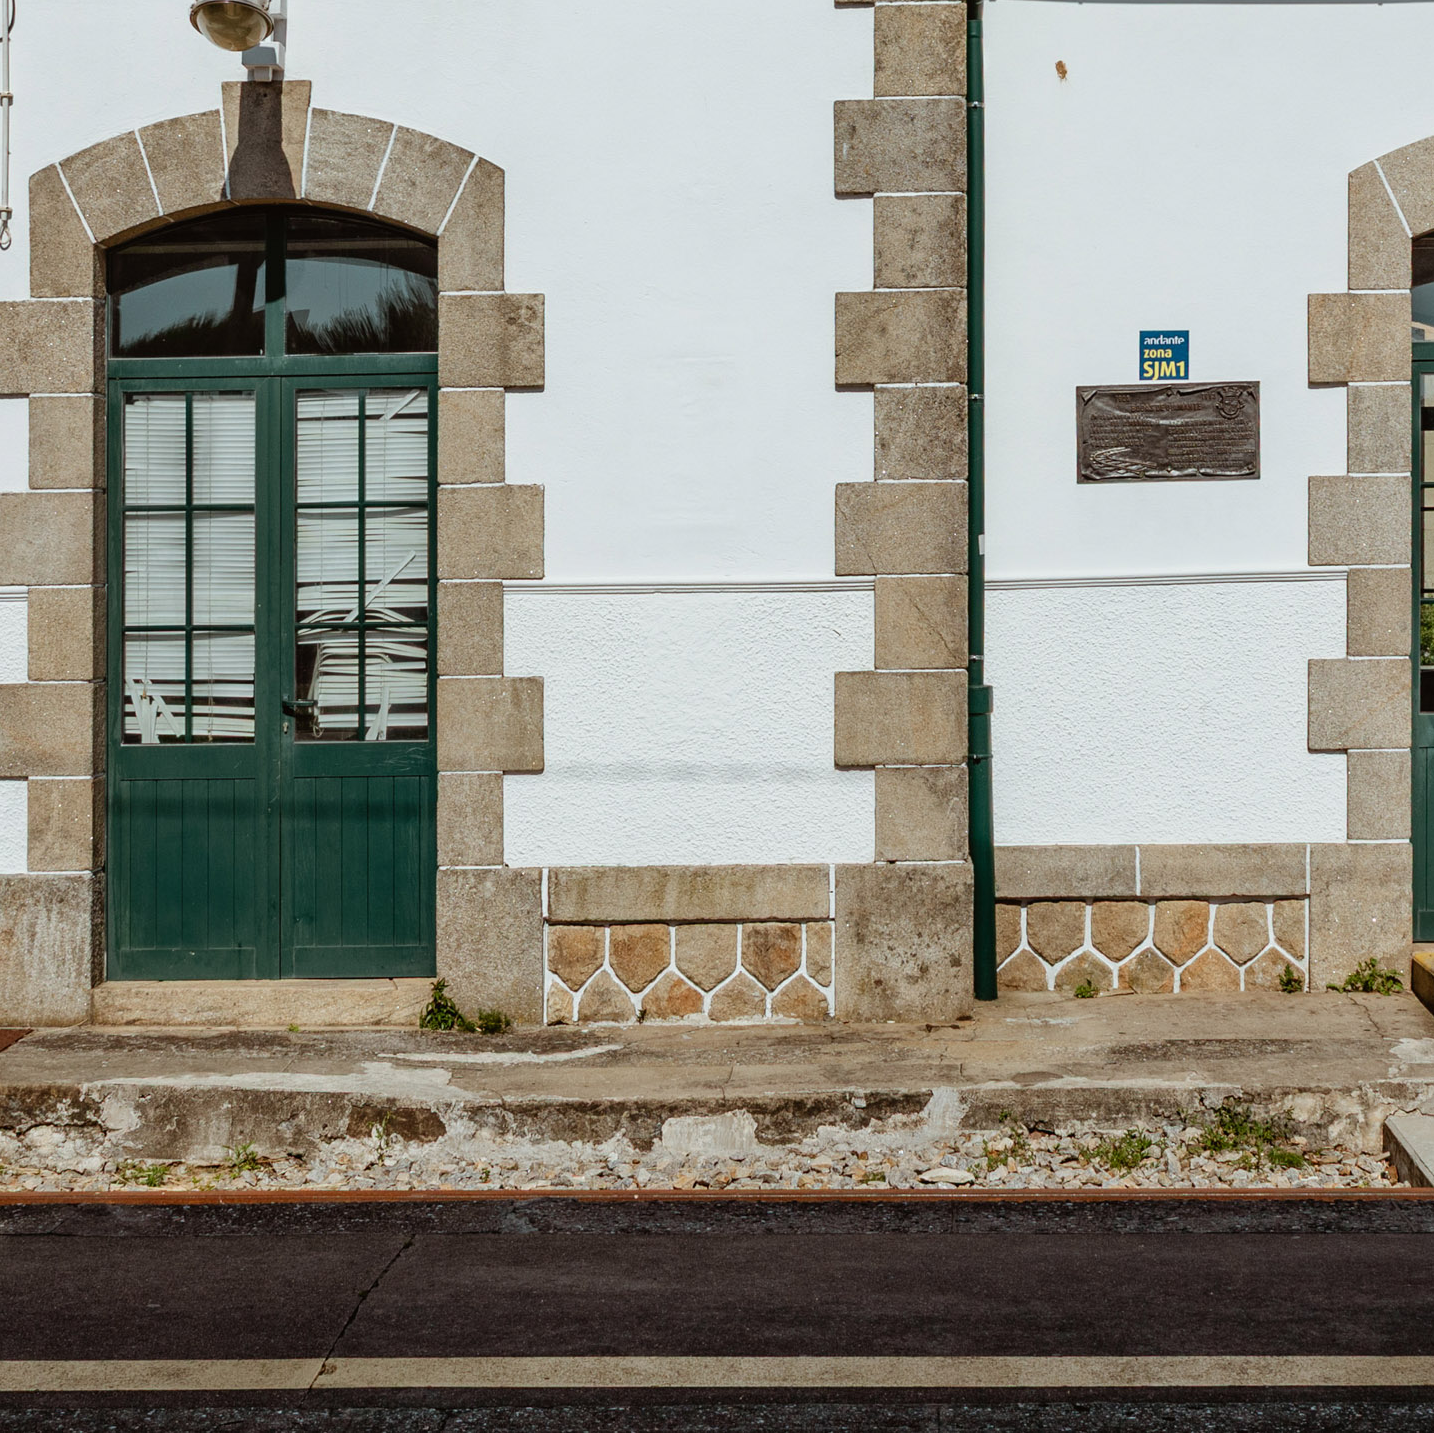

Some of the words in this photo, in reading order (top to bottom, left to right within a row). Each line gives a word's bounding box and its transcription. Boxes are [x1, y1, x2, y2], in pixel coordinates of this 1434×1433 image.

[1143, 334, 1185, 345] andante
[1143, 348, 1173, 359] zona
[1142, 360, 1185, 381] SJM1
